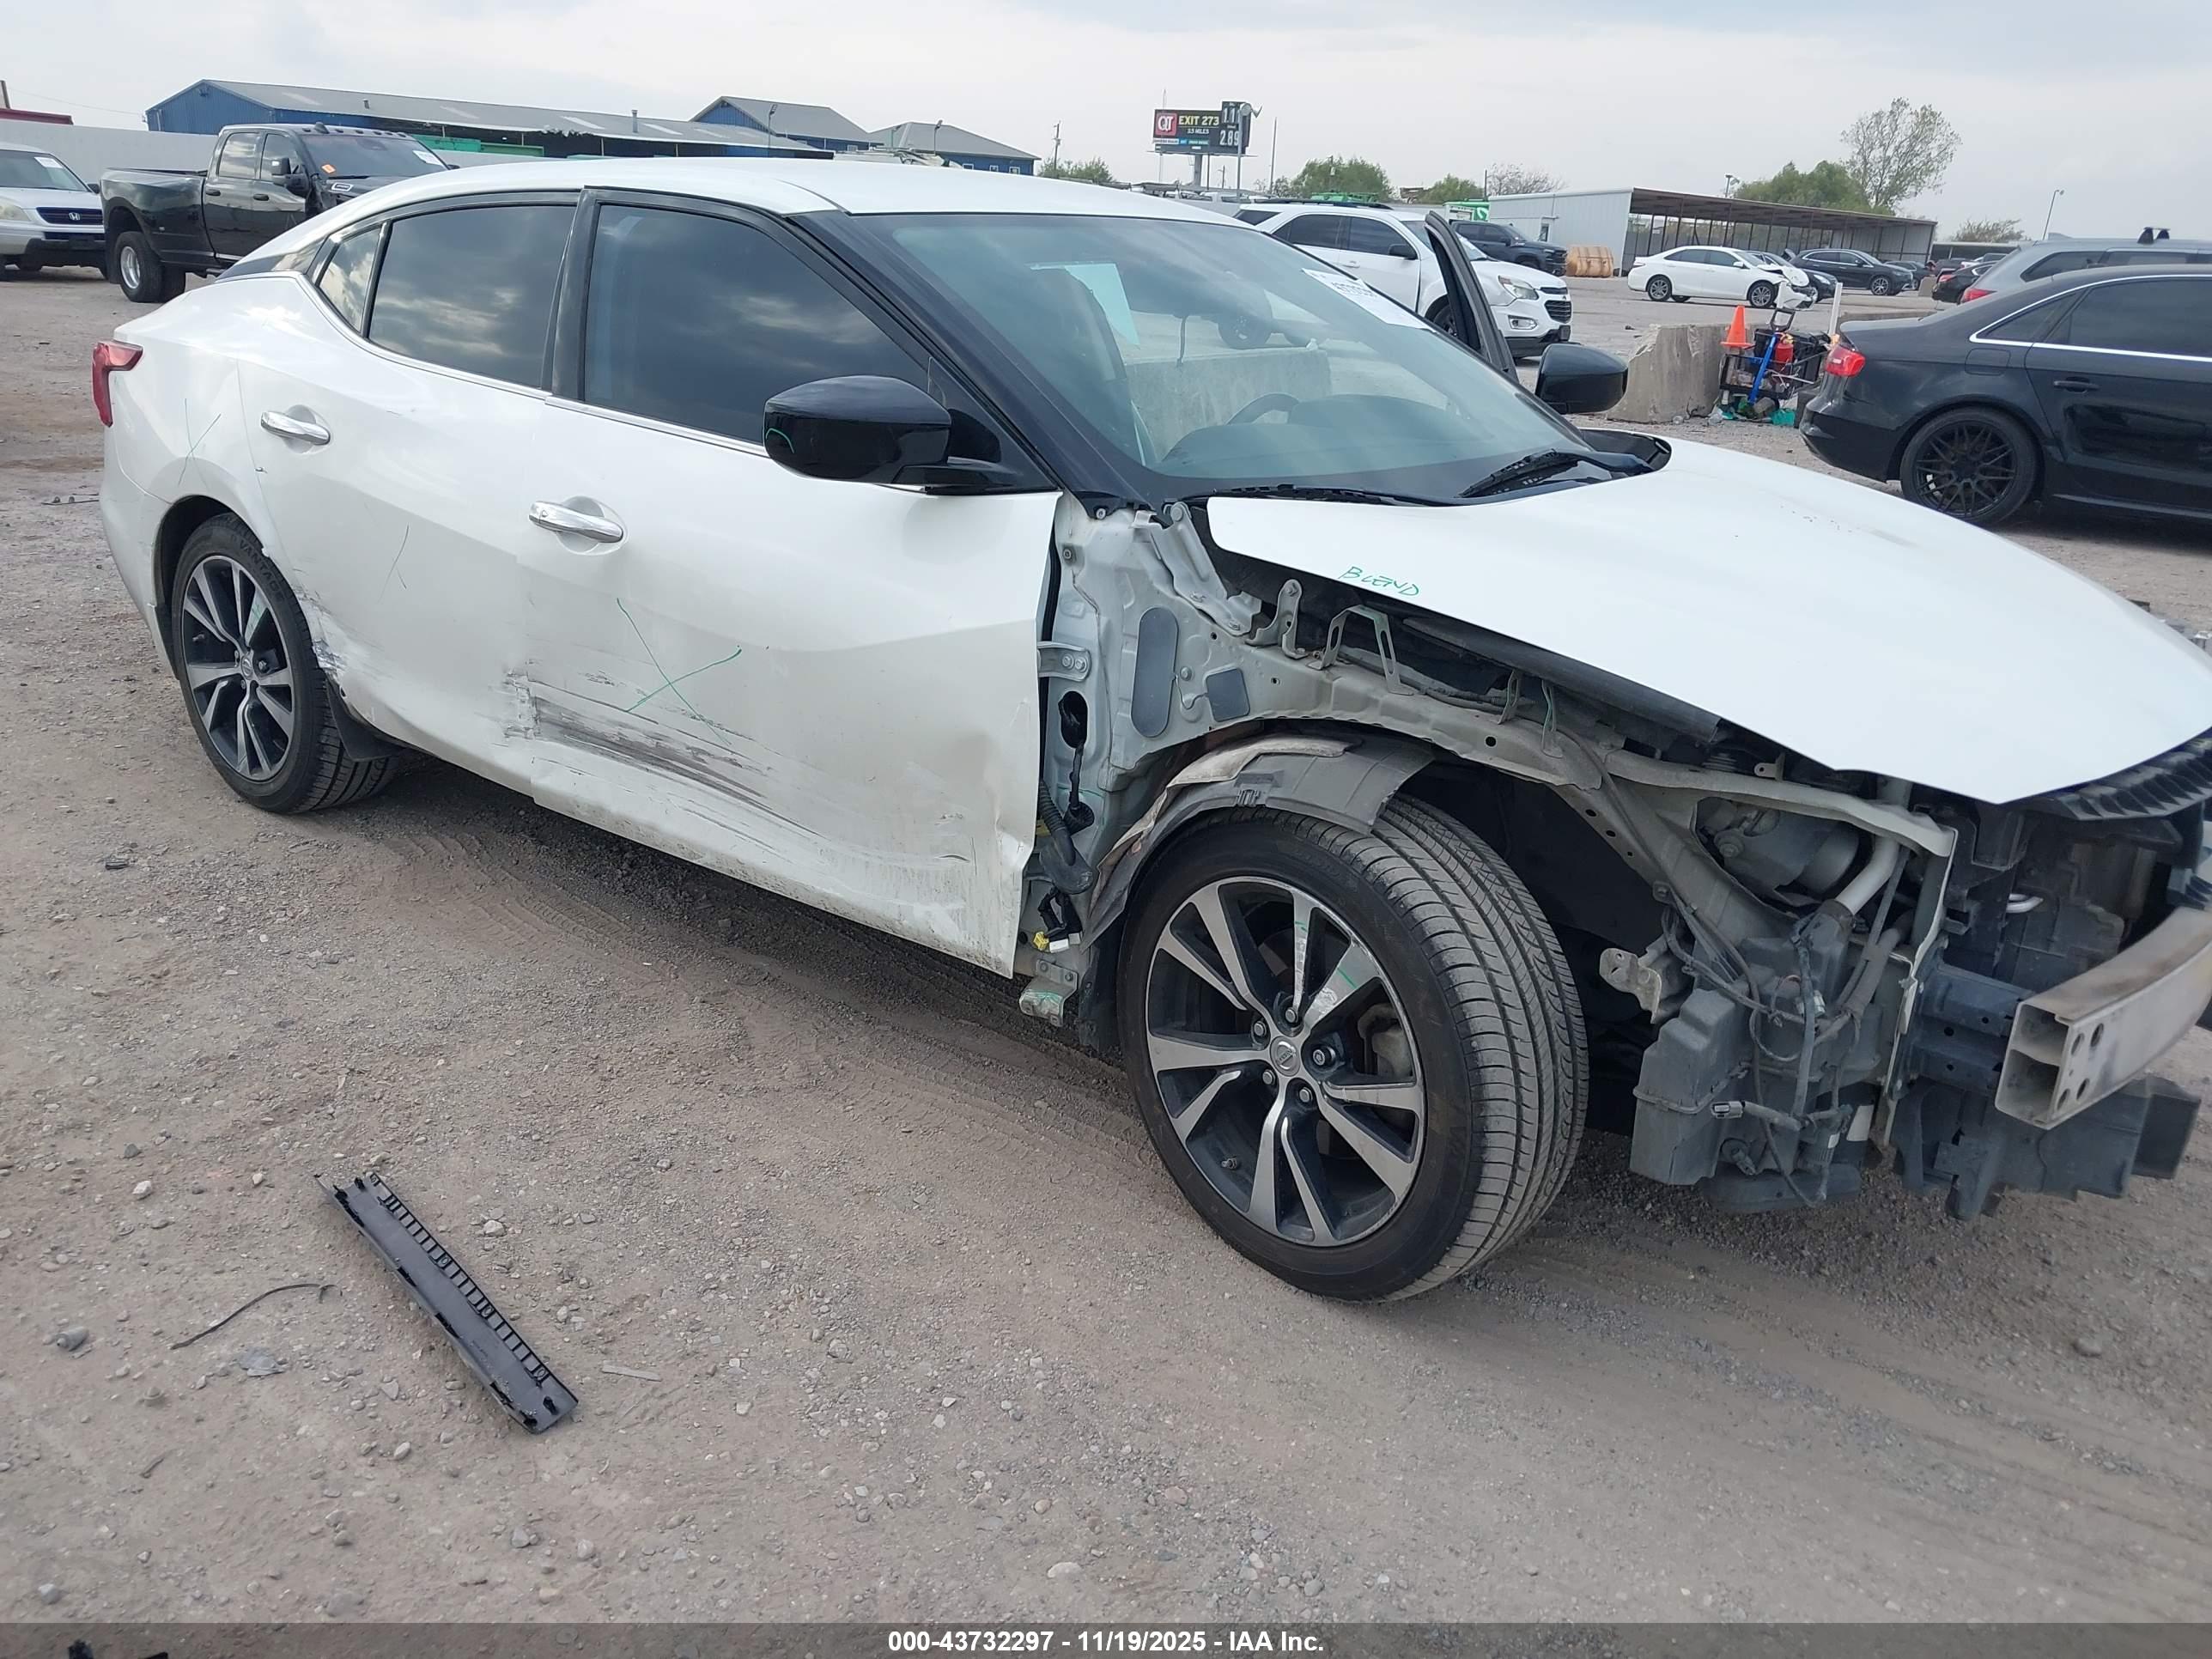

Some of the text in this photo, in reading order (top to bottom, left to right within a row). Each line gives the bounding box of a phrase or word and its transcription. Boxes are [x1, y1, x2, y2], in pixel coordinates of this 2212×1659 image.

[1158, 115, 1174, 131] QT
[1178, 115, 1219, 126] EXIT 273
[1219, 130, 1239, 146] 2.89
